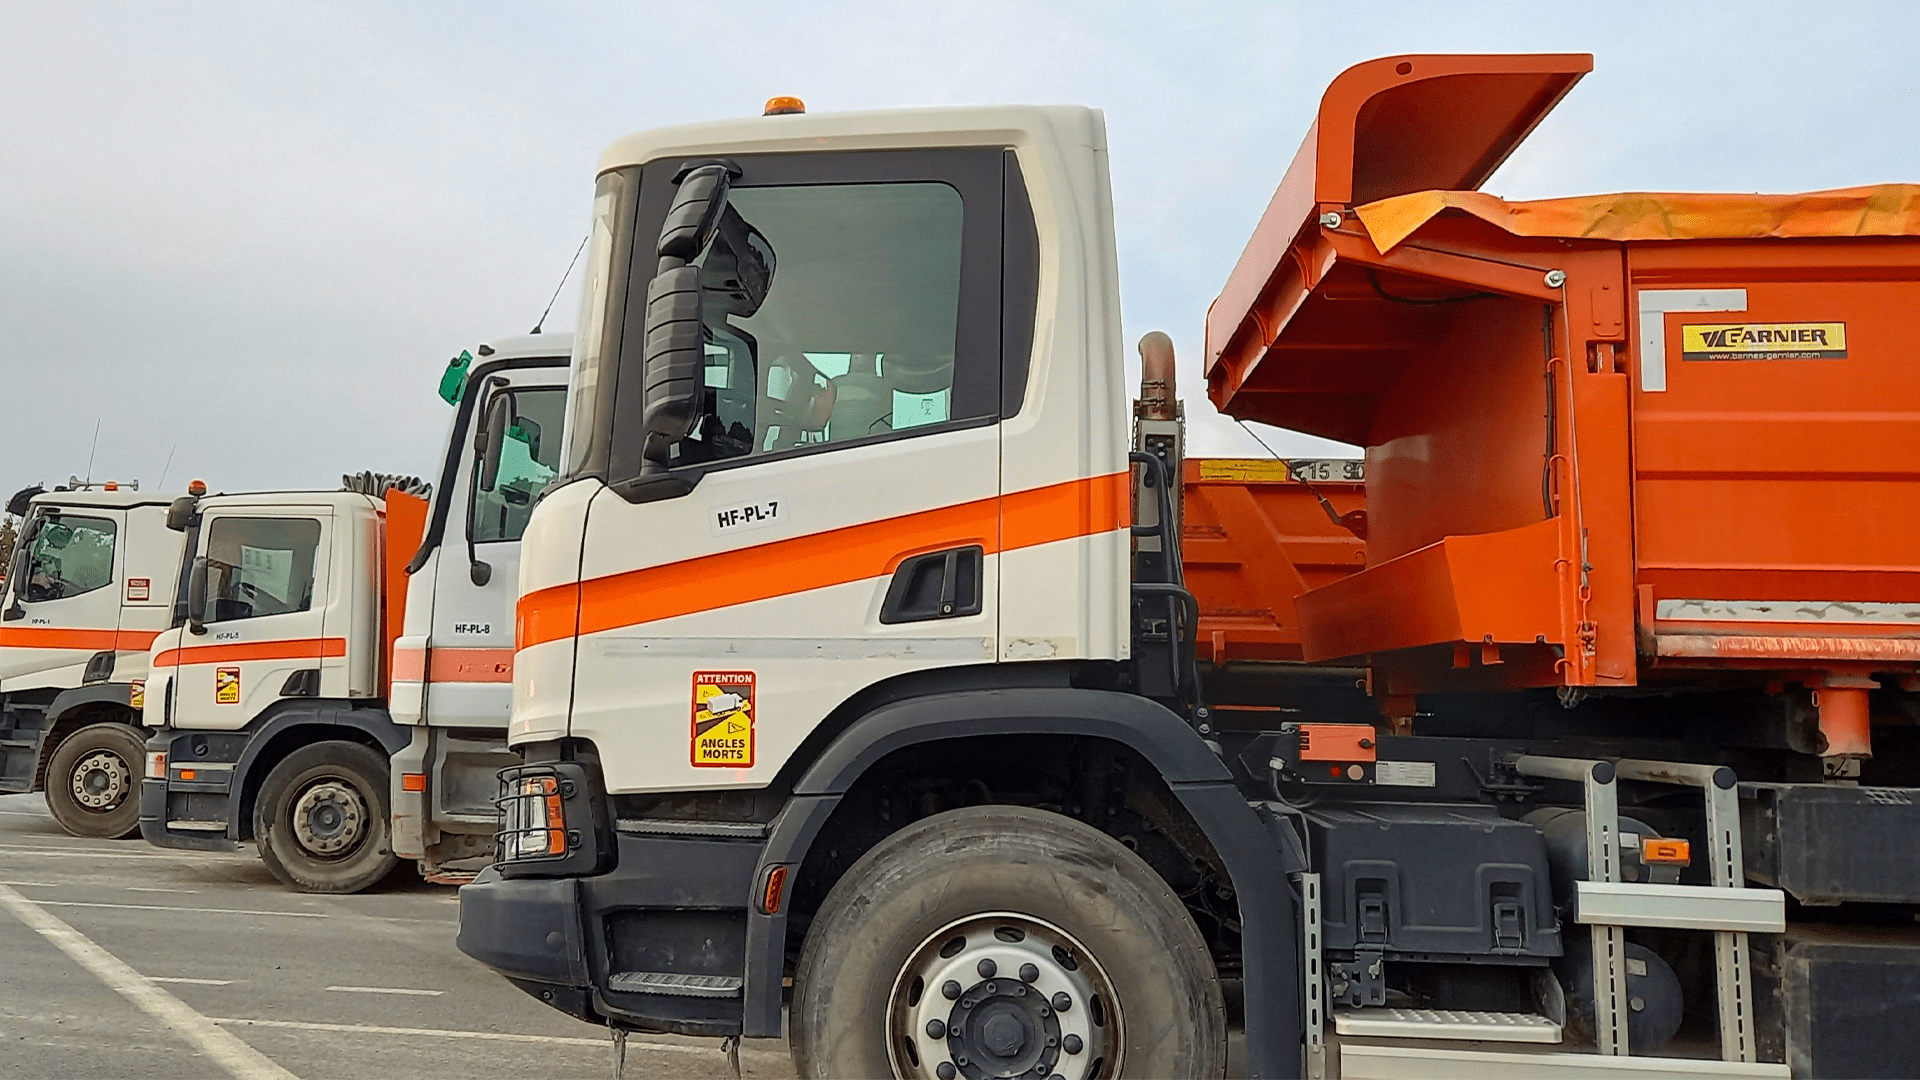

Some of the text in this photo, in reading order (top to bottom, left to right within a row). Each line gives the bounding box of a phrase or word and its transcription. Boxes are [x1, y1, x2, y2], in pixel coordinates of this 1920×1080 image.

[1717, 328, 1828, 347] GARNIER
[1709, 352, 1821, 360] www.bennes-garnier.com
[717, 501, 778, 528] HF-PL-7
[455, 623, 490, 634] HF-PL-8
[697, 674, 752, 683] ATTENTION
[701, 739, 746, 749] ANGLES
[703, 749, 743, 759] MORTS
